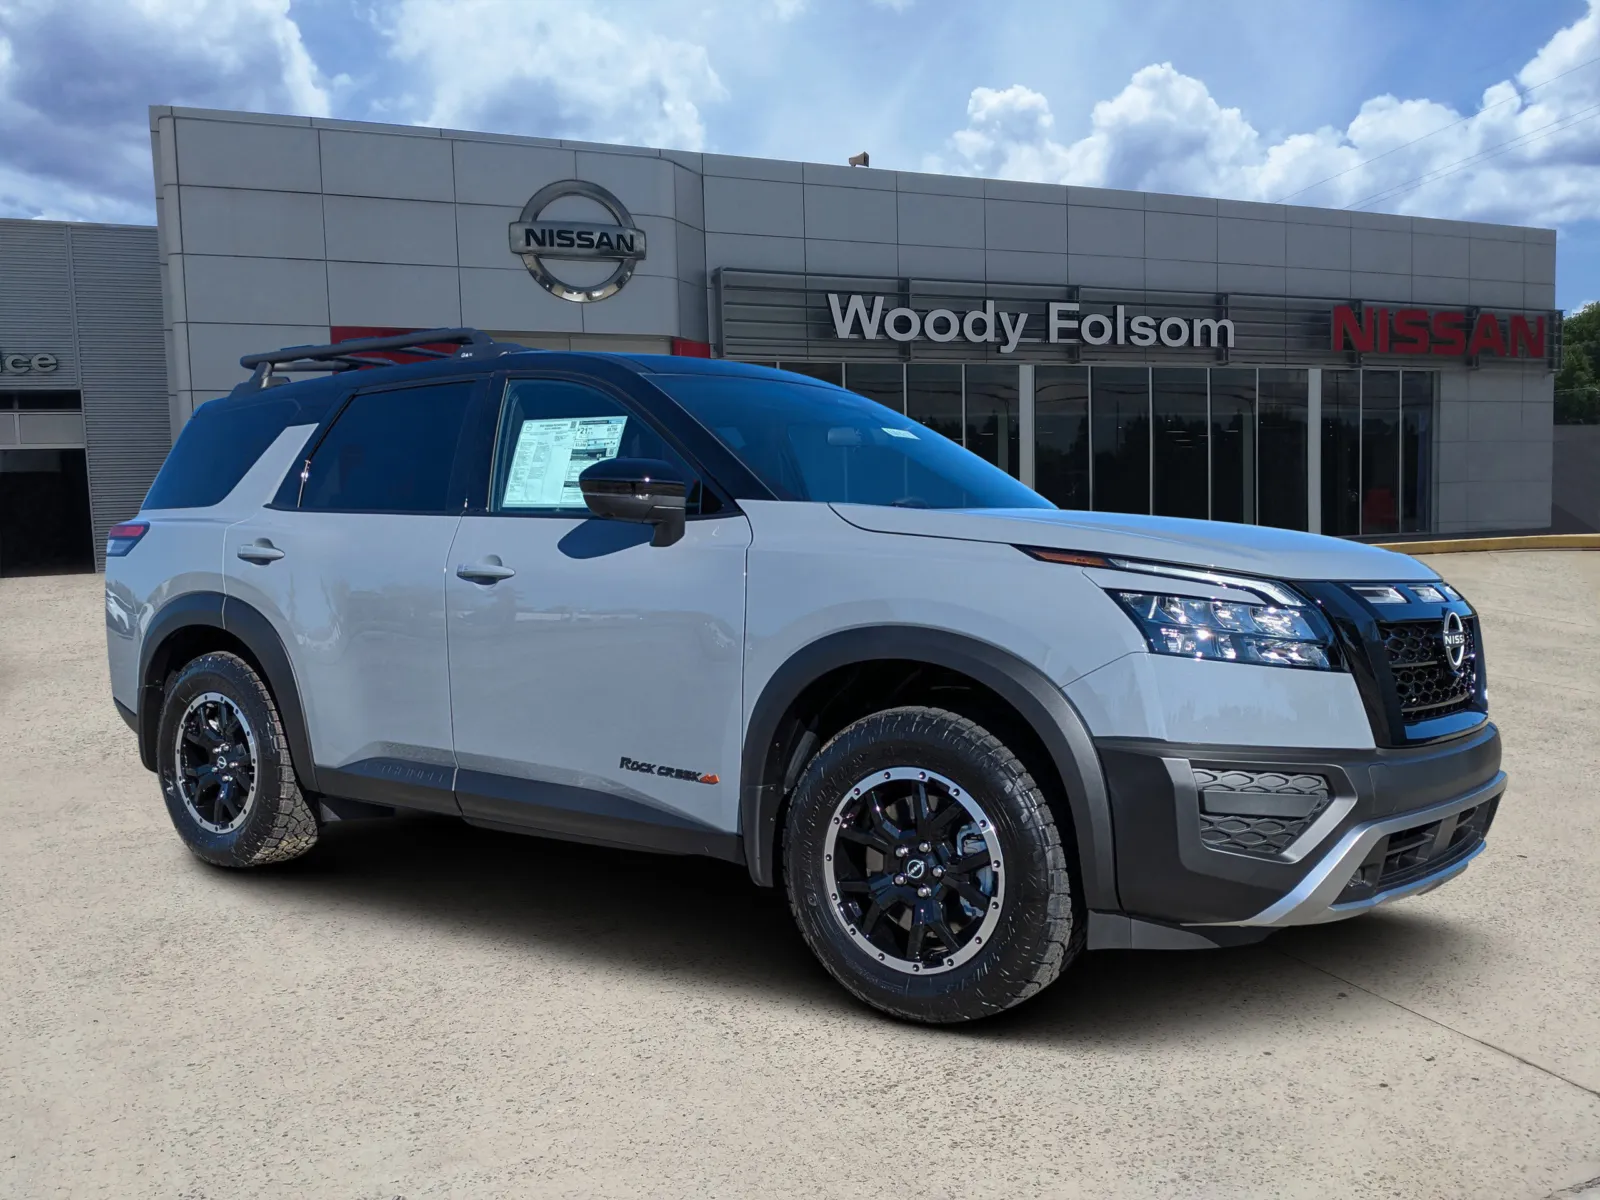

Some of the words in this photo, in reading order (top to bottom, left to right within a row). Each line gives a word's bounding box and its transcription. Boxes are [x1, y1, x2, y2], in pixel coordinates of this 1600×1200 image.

[525, 228, 635, 252] NISSAN
[827, 293, 1028, 353] Woody
[1048, 301, 1235, 348] Folsom
[1332, 305, 1545, 358] NISSAN
[0, 353, 57, 374] ce
[619, 756, 656, 775] ROCK
[656, 766, 702, 783] CREEK
